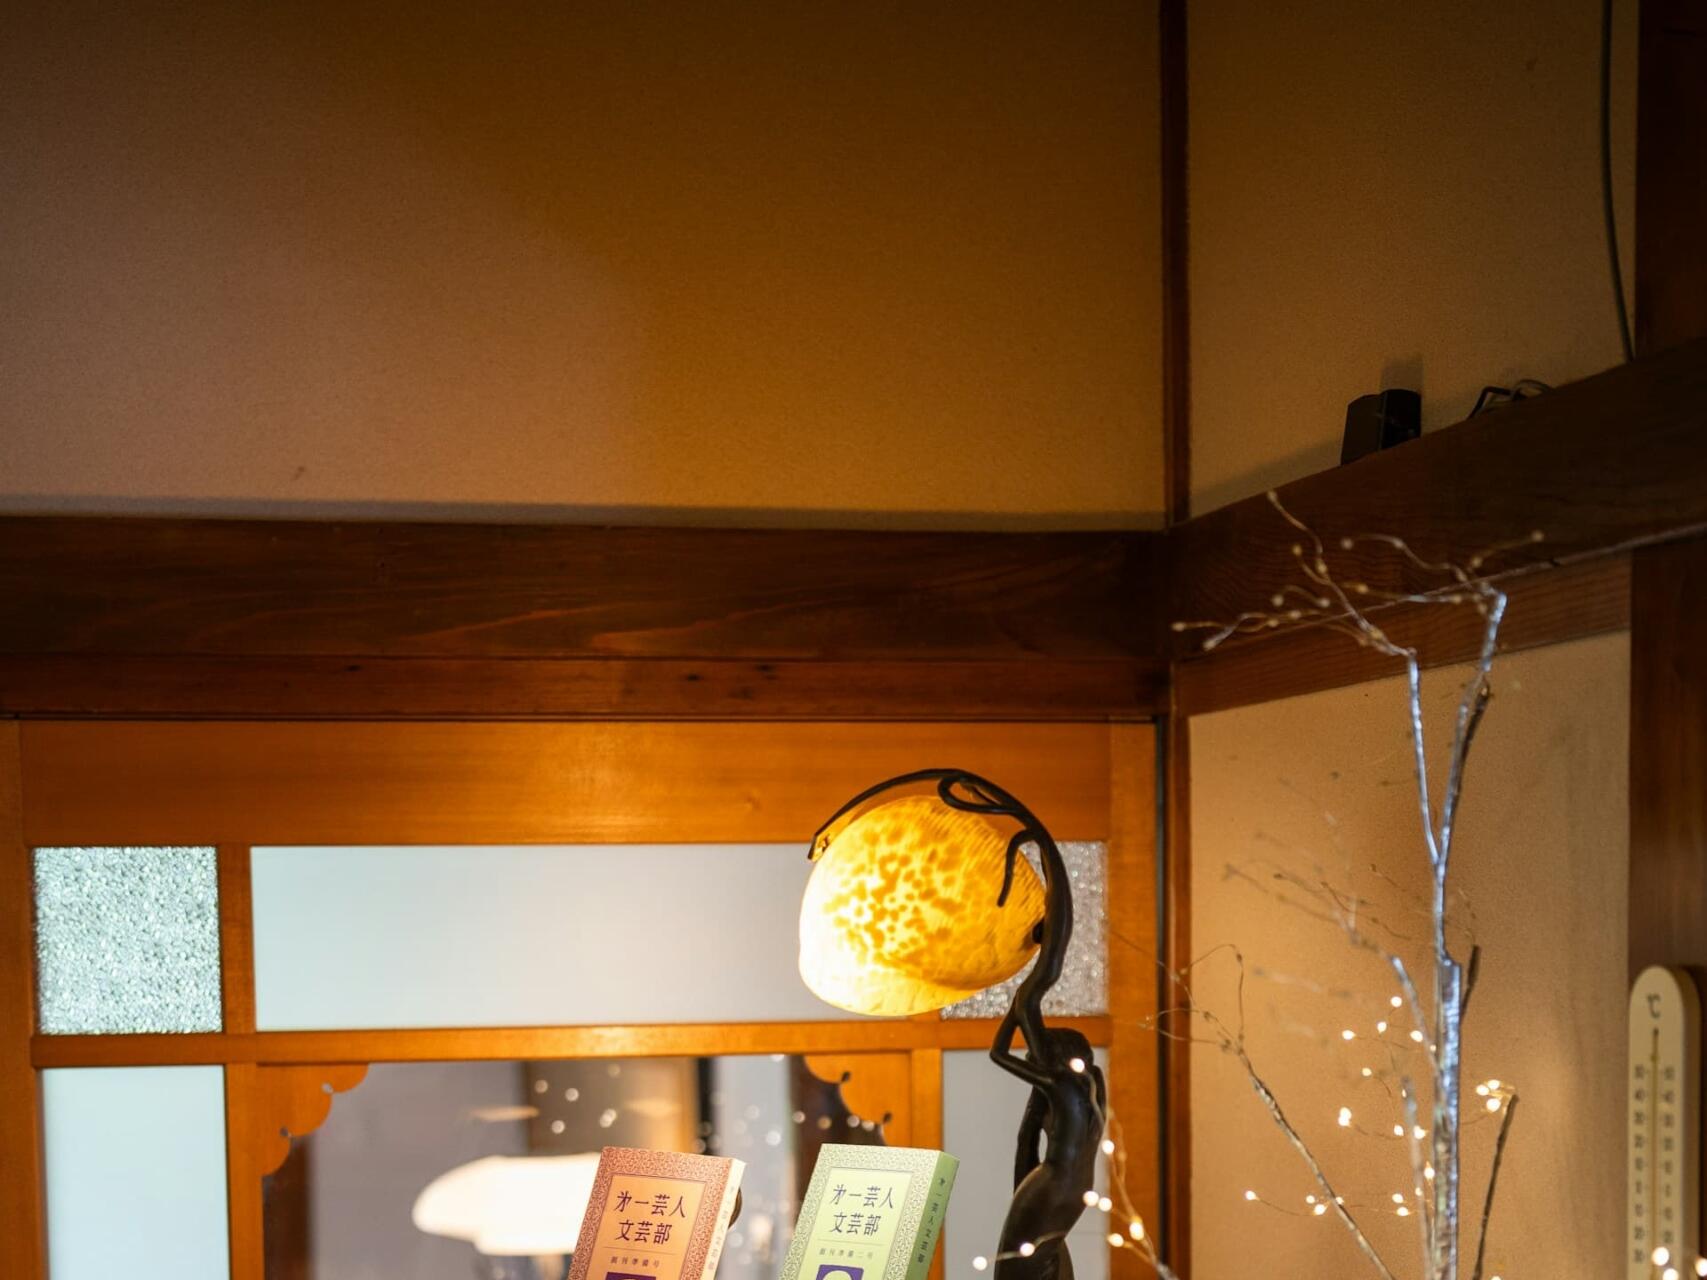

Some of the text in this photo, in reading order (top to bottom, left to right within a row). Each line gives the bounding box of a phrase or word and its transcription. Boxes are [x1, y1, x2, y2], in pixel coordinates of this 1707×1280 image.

[615, 1219, 673, 1245] 文芸部
[829, 1211, 882, 1236] 文芸部
